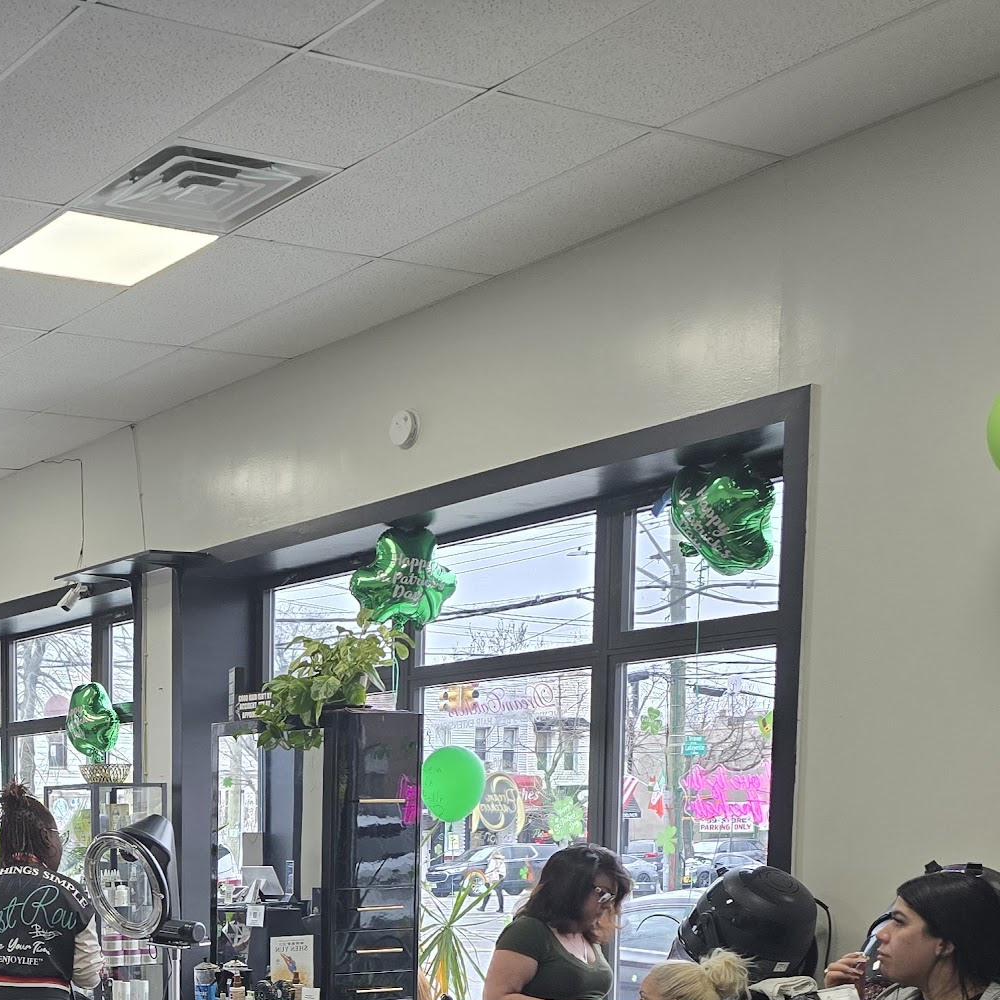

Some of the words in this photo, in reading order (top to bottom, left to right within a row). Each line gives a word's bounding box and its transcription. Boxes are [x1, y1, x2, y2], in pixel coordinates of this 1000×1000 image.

[696, 486, 731, 537] Happy
[393, 584, 424, 606] Day
[42, 870, 89, 909] SIMPLE
[7, 937, 32, 952] Your
[32, 940, 51, 956] Tim
